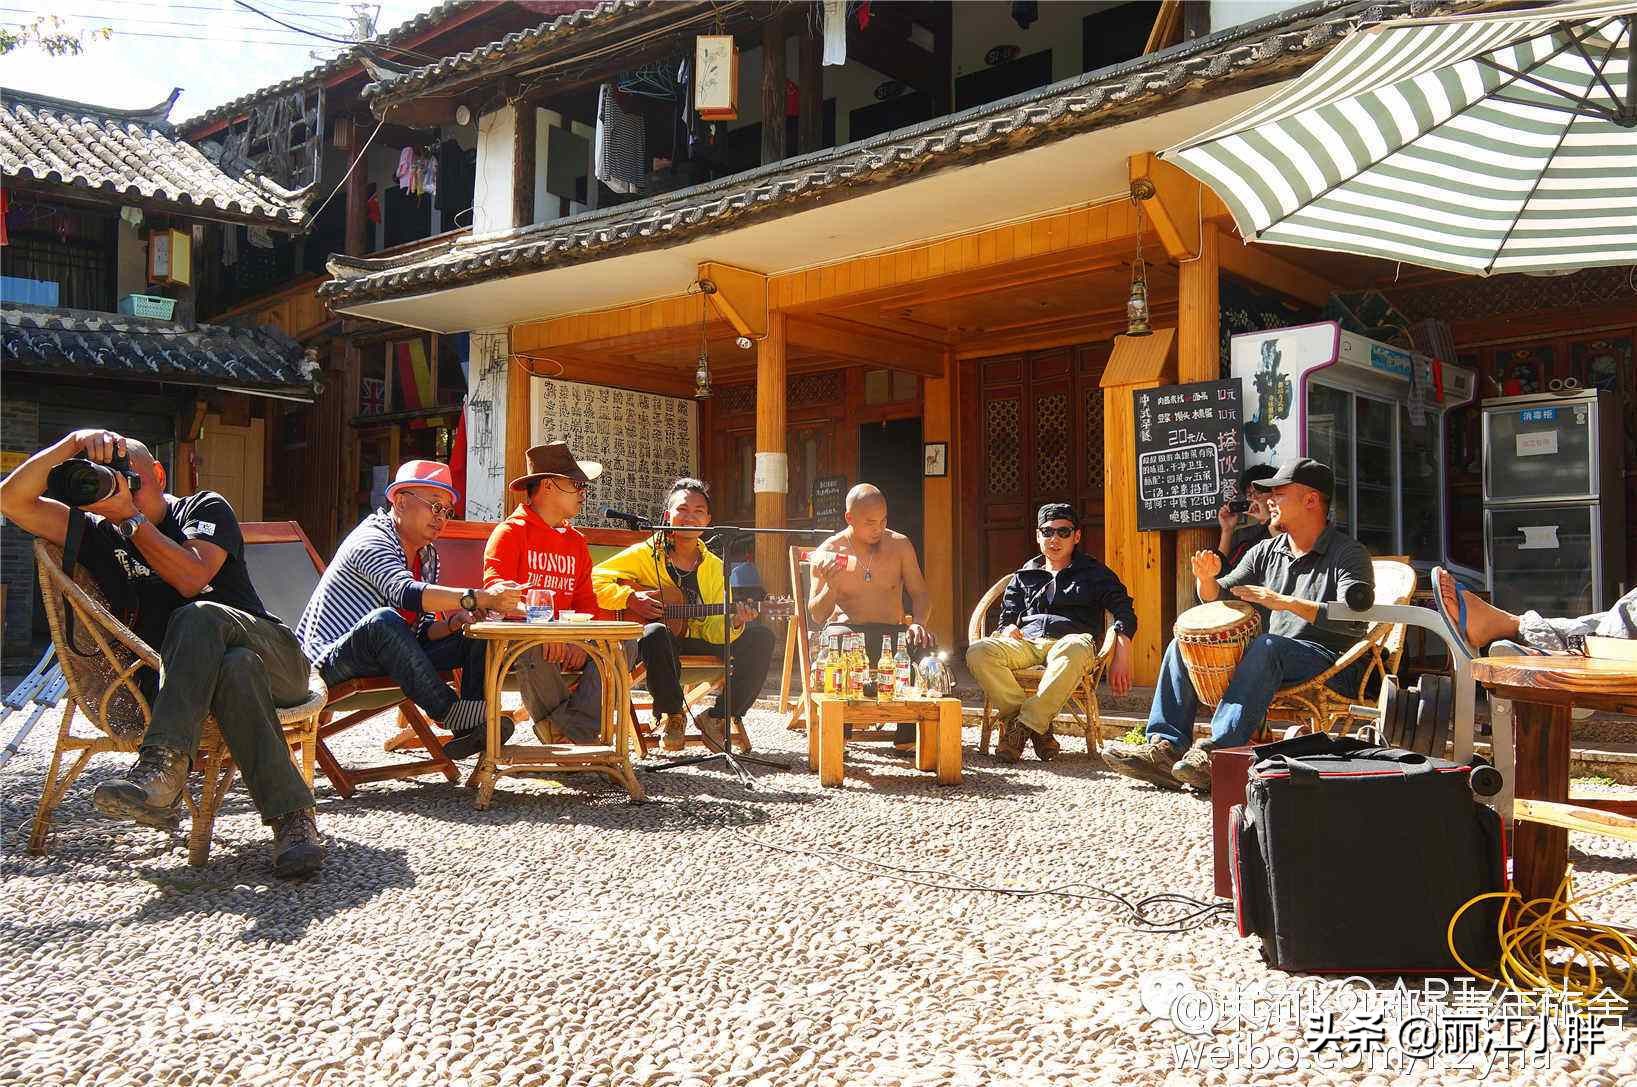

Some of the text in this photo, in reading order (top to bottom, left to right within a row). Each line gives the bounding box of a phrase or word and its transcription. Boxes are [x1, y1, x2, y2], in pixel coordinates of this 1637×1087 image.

[1168, 428, 1208, 446] 20元/人
[527, 549, 576, 575] HONOR
[527, 572, 575, 591] THE BRAVE
